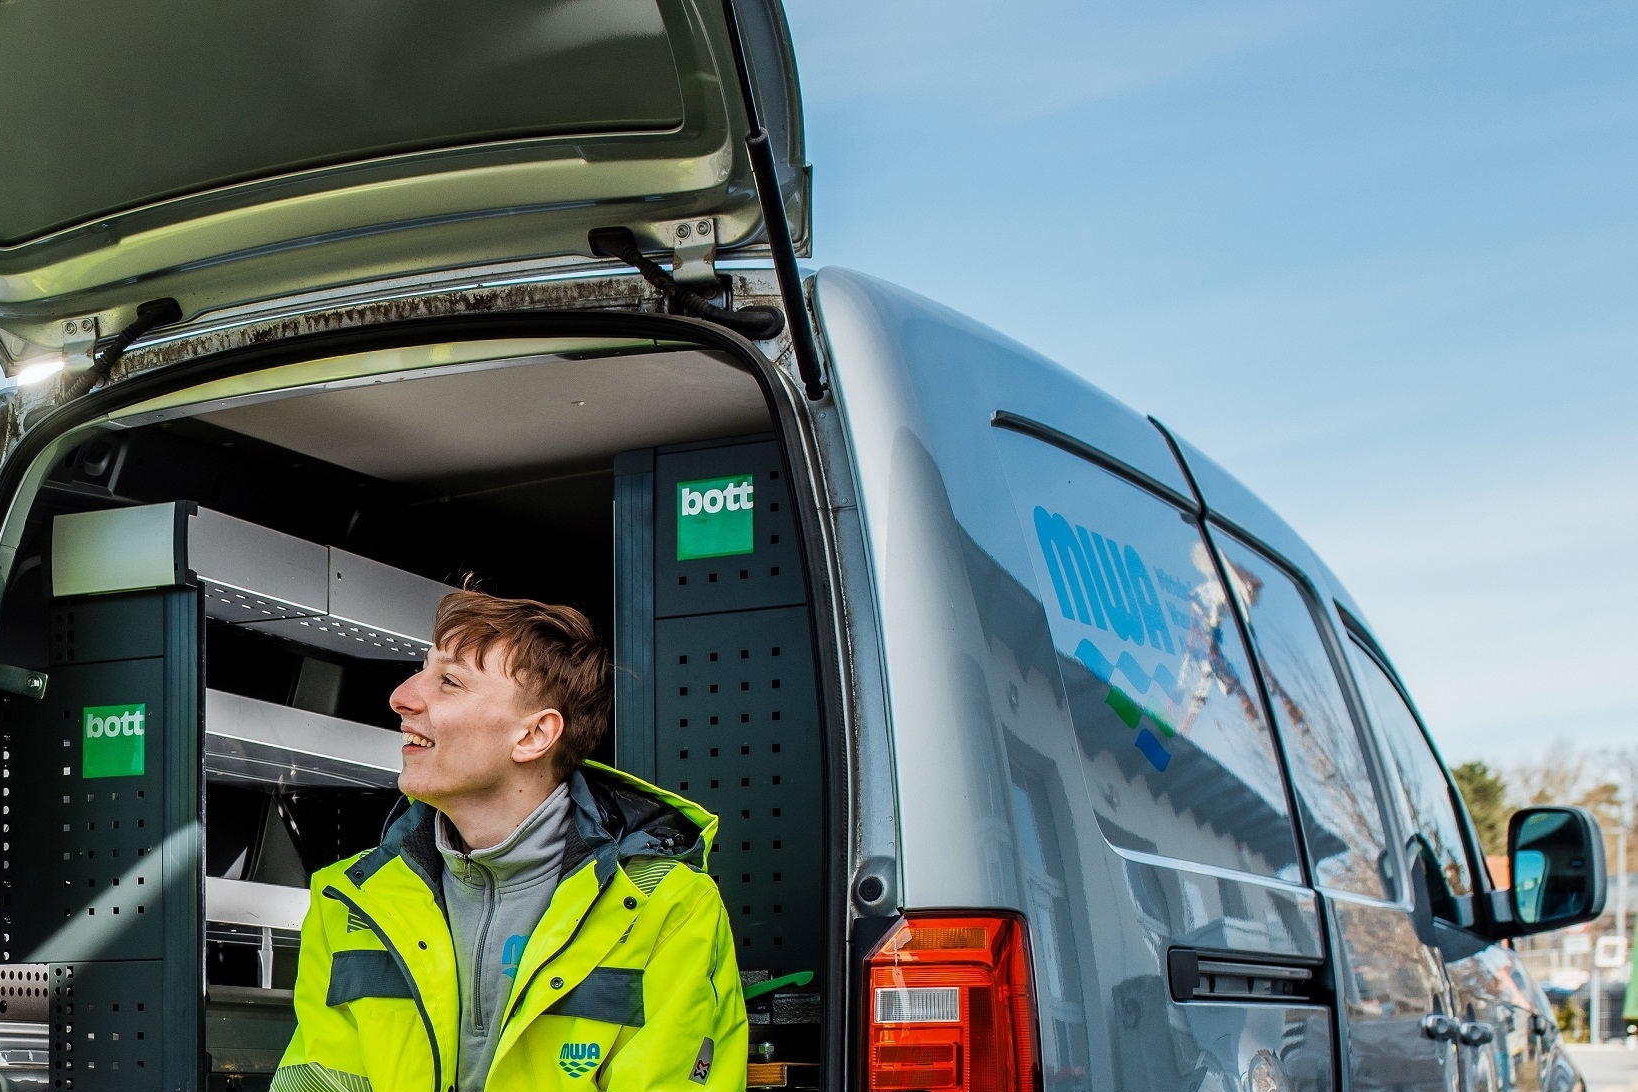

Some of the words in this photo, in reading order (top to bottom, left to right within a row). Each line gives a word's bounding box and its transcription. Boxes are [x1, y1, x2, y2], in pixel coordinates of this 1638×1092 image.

[682, 481, 754, 516] bott
[1033, 505, 1177, 656] MWA
[86, 710, 146, 738] bott
[559, 1042, 600, 1060] MWA
